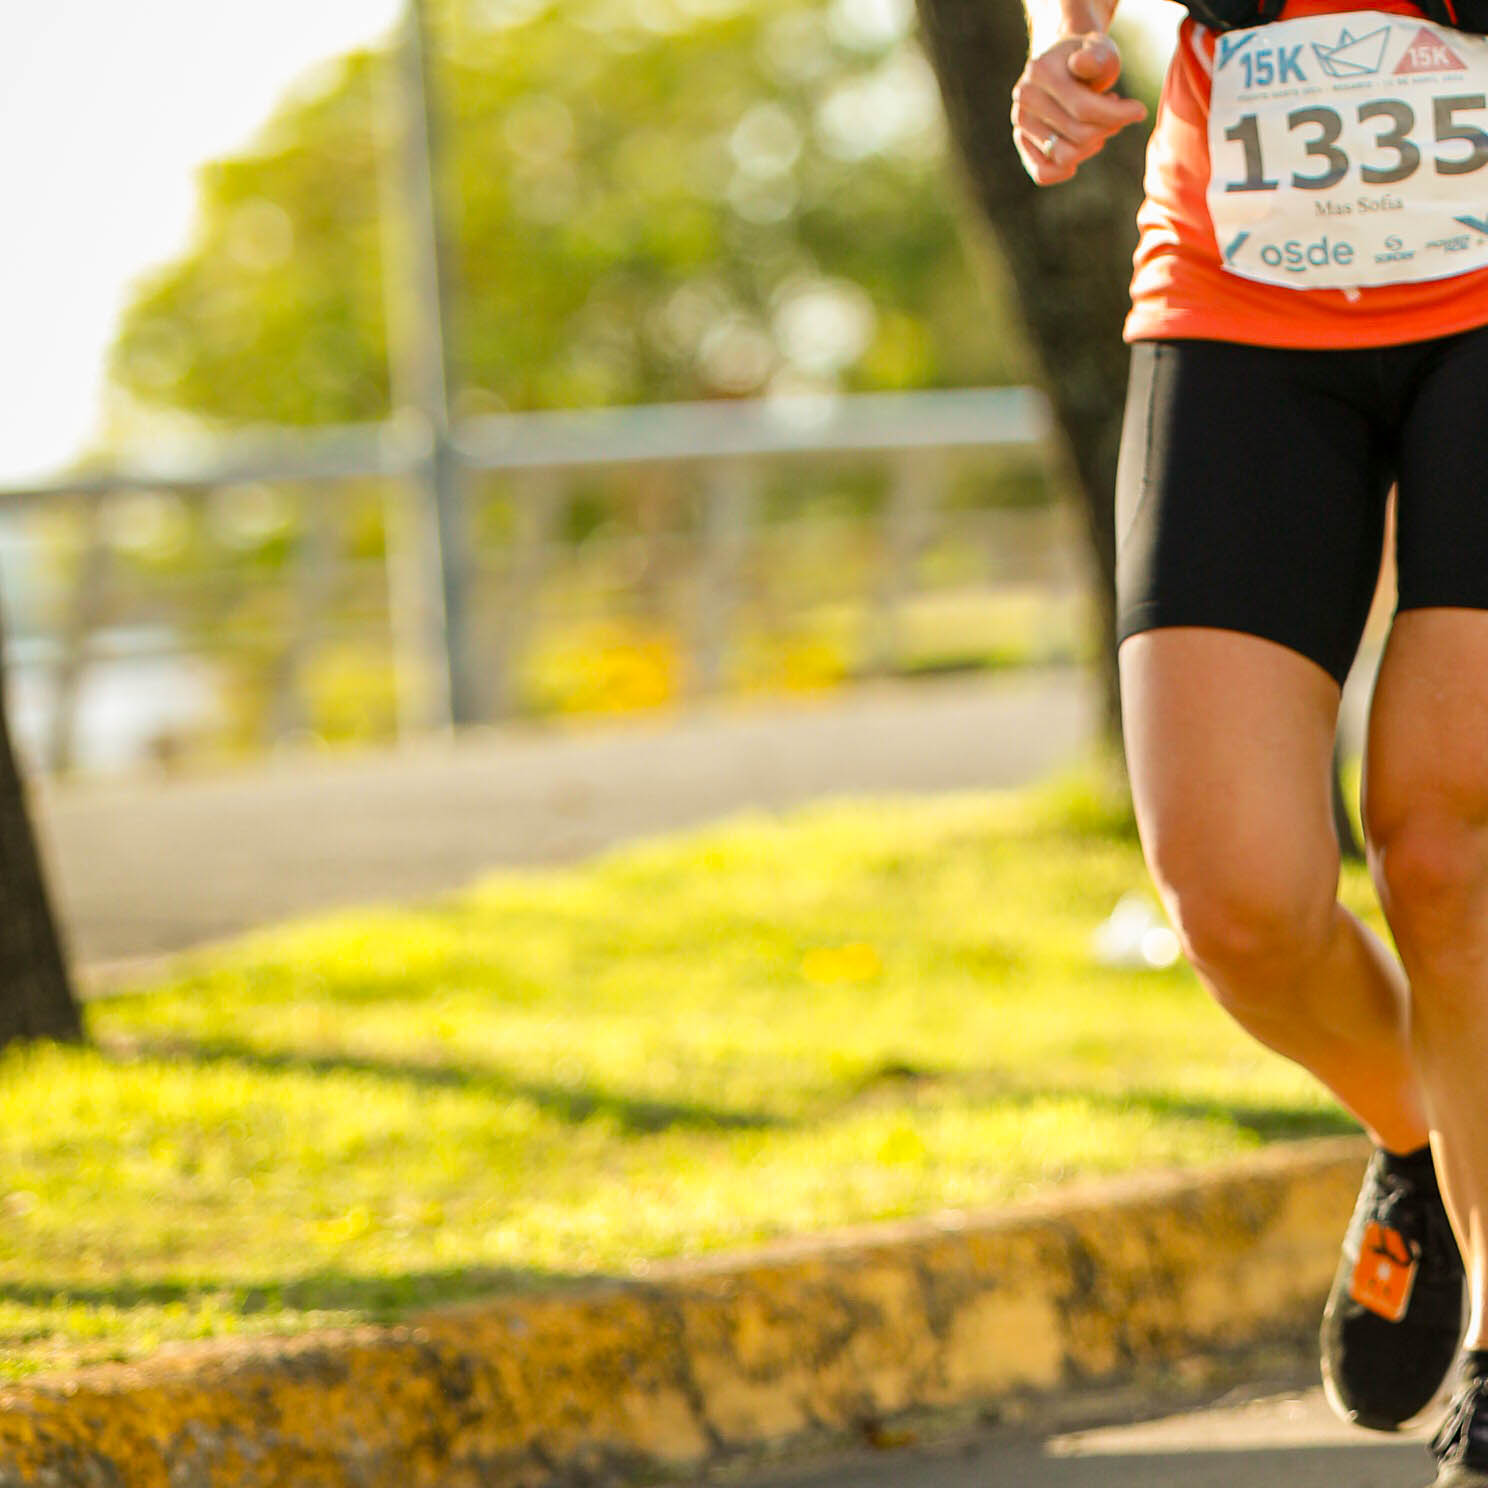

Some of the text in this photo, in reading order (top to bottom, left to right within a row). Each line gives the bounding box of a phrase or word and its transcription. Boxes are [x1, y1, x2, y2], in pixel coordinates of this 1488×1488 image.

[1239, 43, 1307, 88] 15K
[1407, 46, 1451, 67] 15K
[1314, 200, 1352, 216] Mas
[1260, 235, 1354, 268] osde
